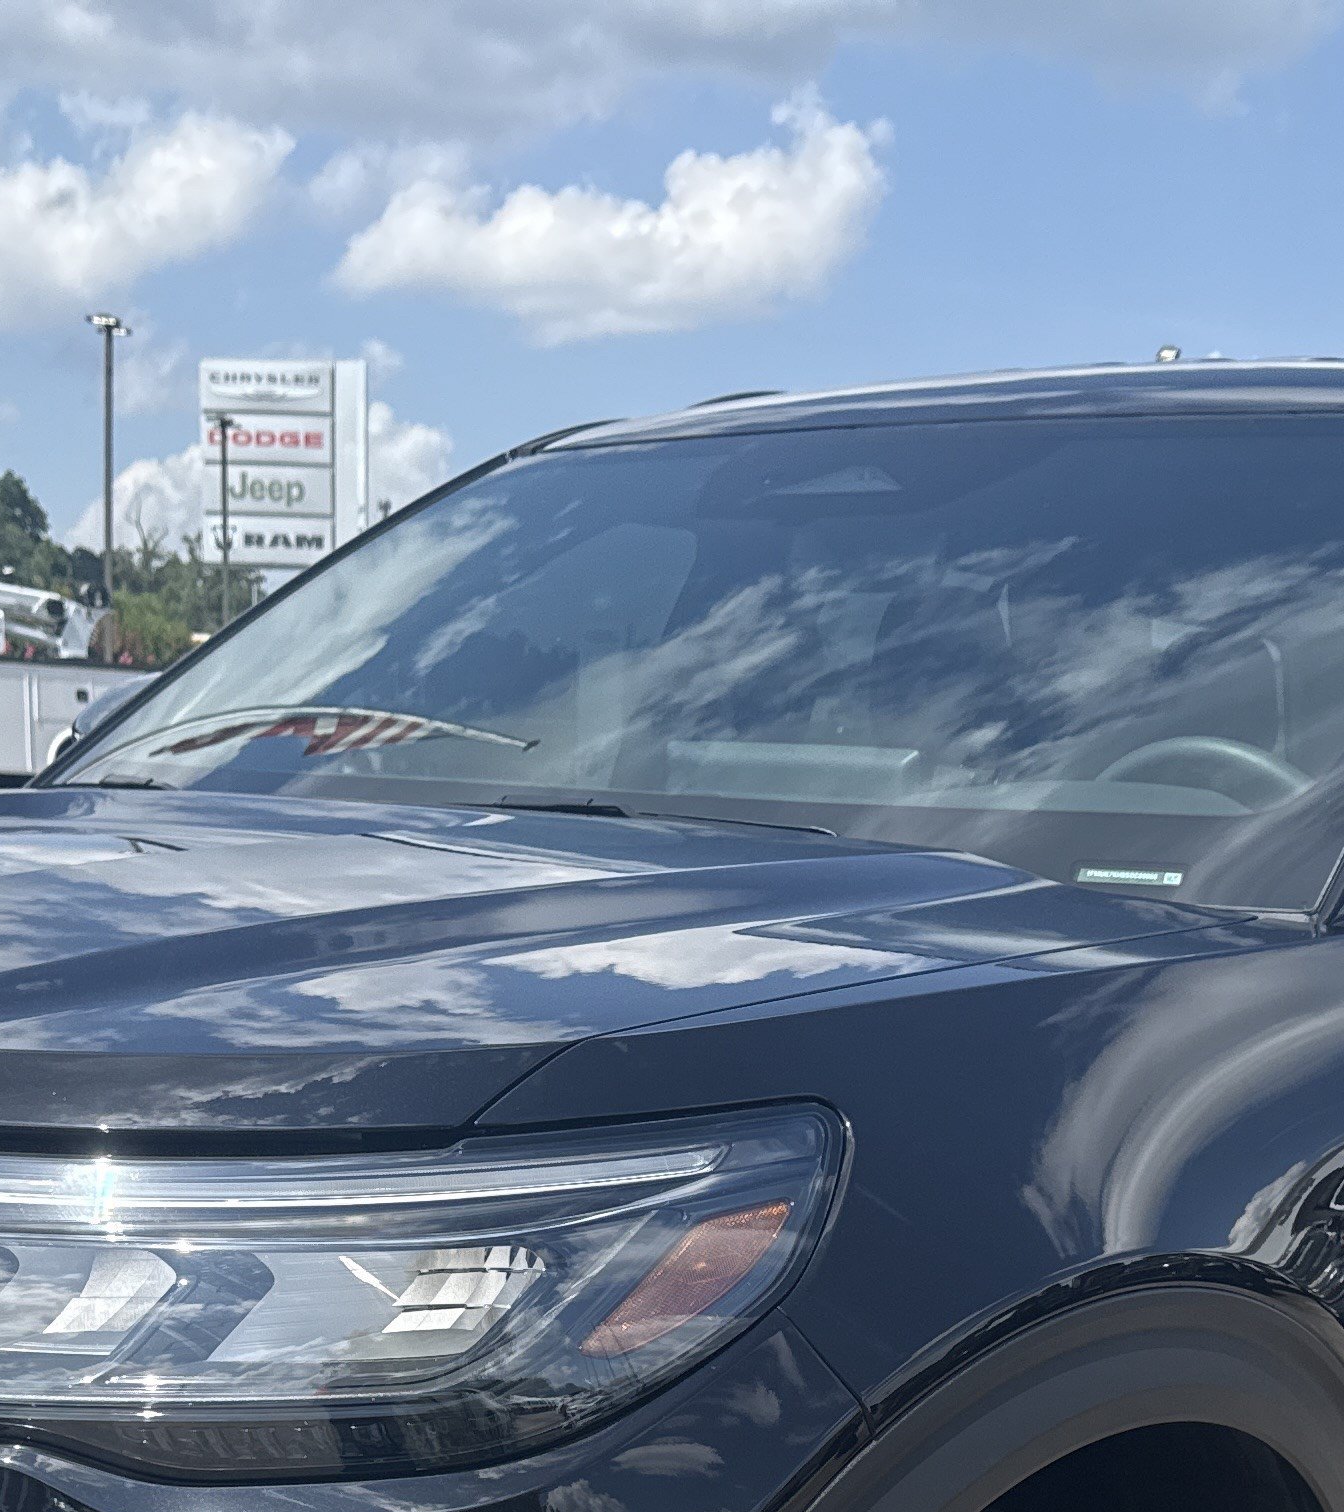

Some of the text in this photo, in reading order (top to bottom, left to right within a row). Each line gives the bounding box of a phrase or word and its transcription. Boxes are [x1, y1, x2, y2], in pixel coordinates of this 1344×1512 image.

[209, 371, 321, 385] CHRYSLER
[207, 430, 325, 449] DODGE
[230, 470, 306, 507] Jeep
[243, 531, 326, 549] RAM
